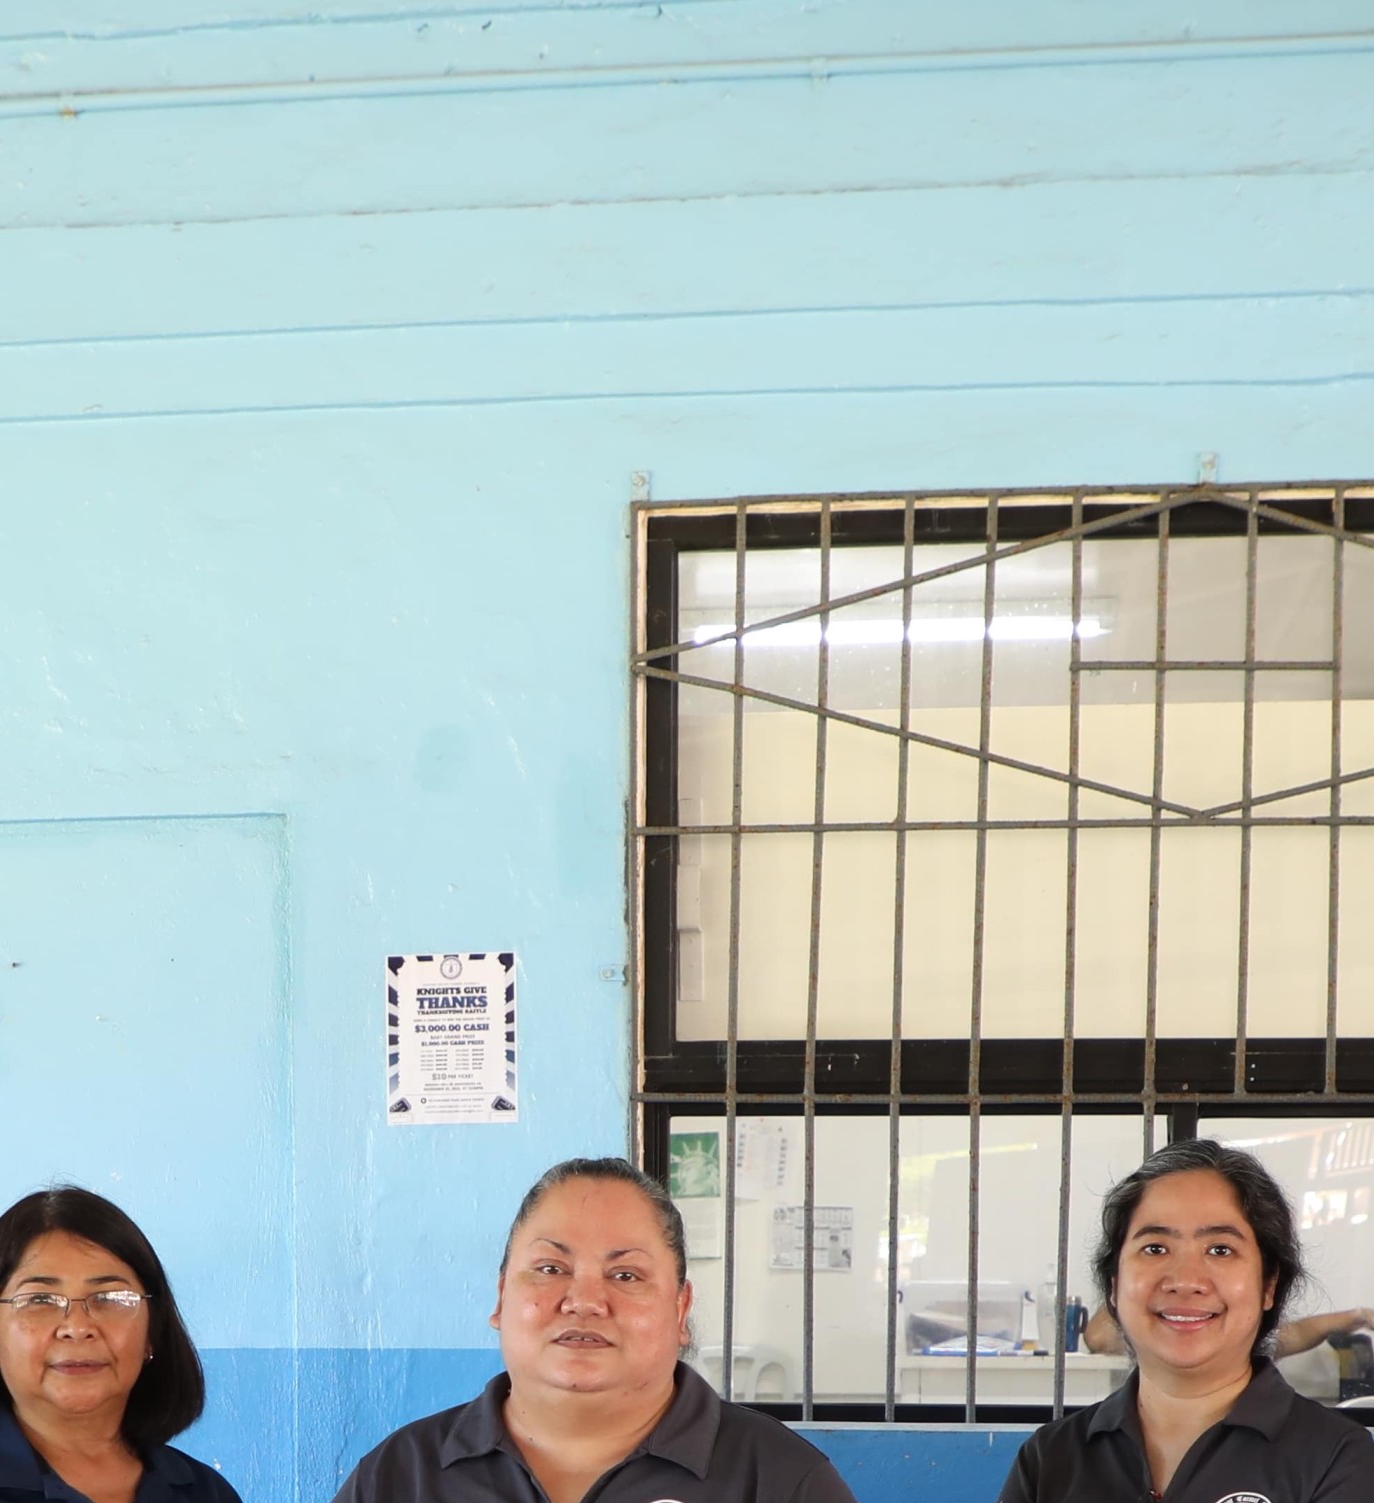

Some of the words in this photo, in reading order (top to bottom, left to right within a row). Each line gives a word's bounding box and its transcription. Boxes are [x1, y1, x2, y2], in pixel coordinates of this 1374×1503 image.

[417, 987, 461, 995] KNIGHTS
[416, 996, 488, 1009] THANKS
[415, 1024, 461, 1033] $3,000.00
